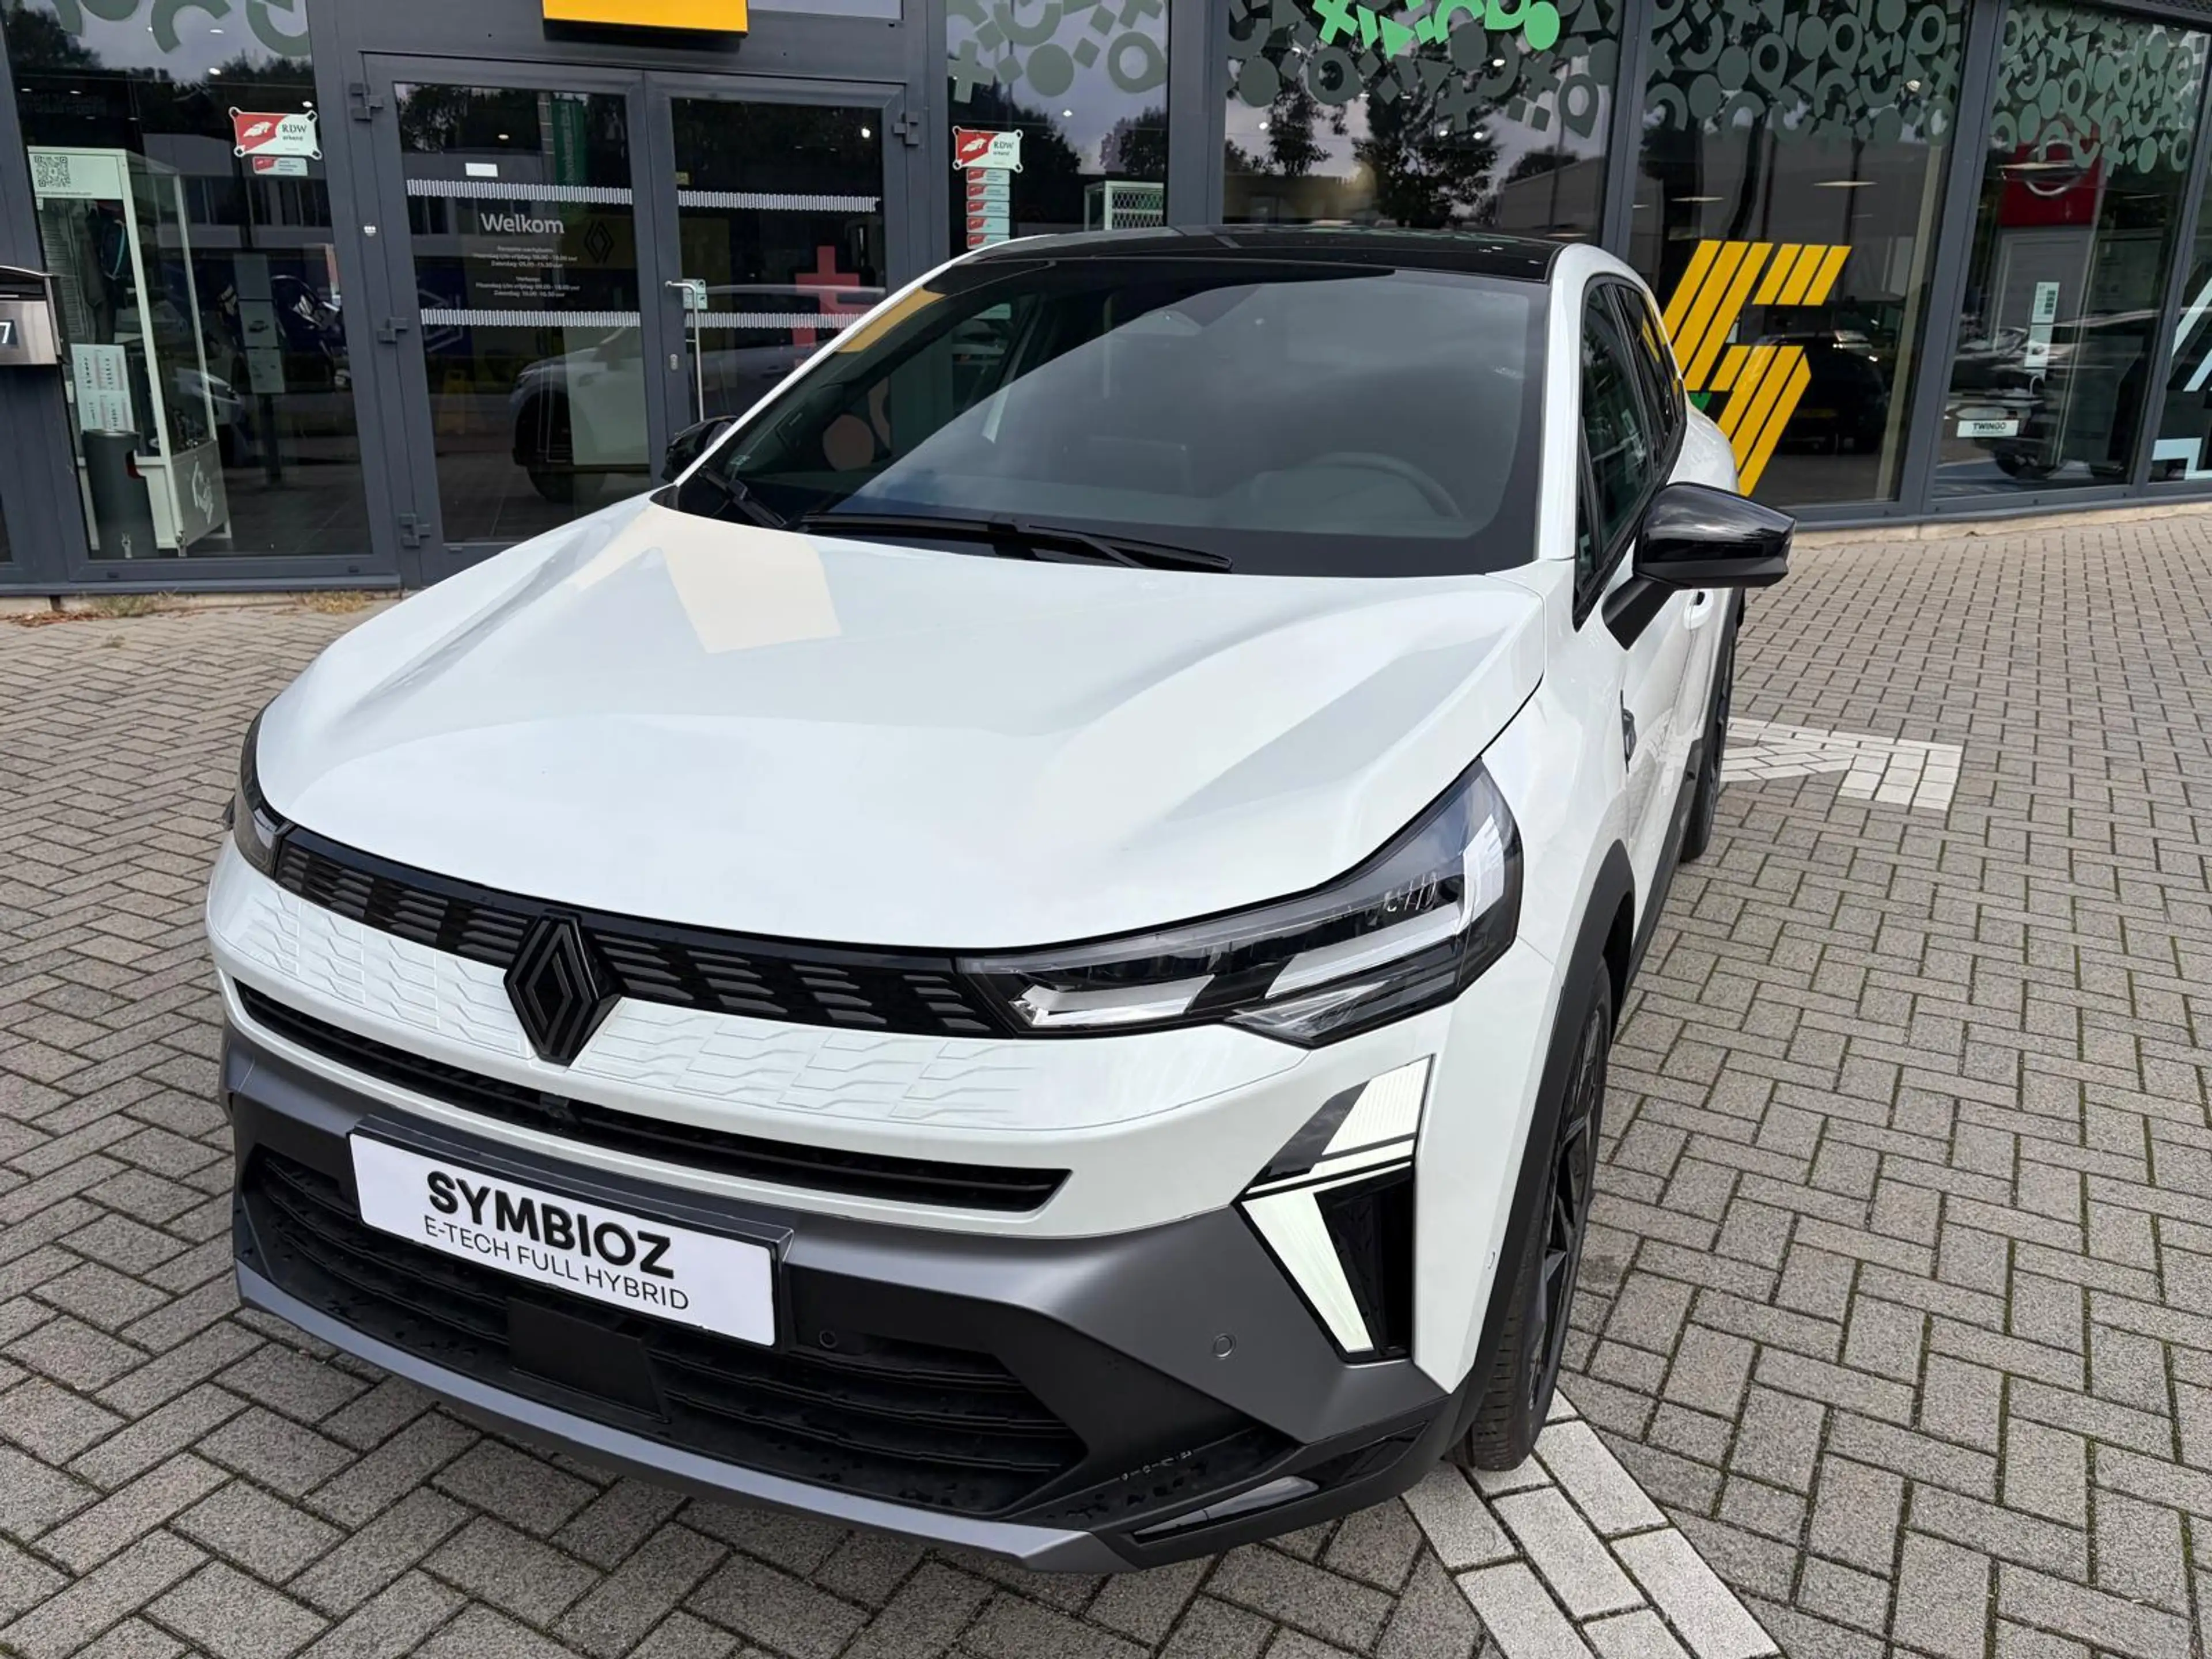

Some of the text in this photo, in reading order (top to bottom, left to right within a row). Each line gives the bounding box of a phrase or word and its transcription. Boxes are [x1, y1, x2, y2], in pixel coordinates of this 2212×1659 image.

[281, 123, 308, 134] RDW
[993, 141, 1014, 149] RDW
[480, 212, 565, 234] Welkom
[1972, 422, 2007, 430] TWINGO
[426, 1171, 675, 1279] SYMBIOZ
[424, 1215, 690, 1310] E-TECH FULL HYBRID
